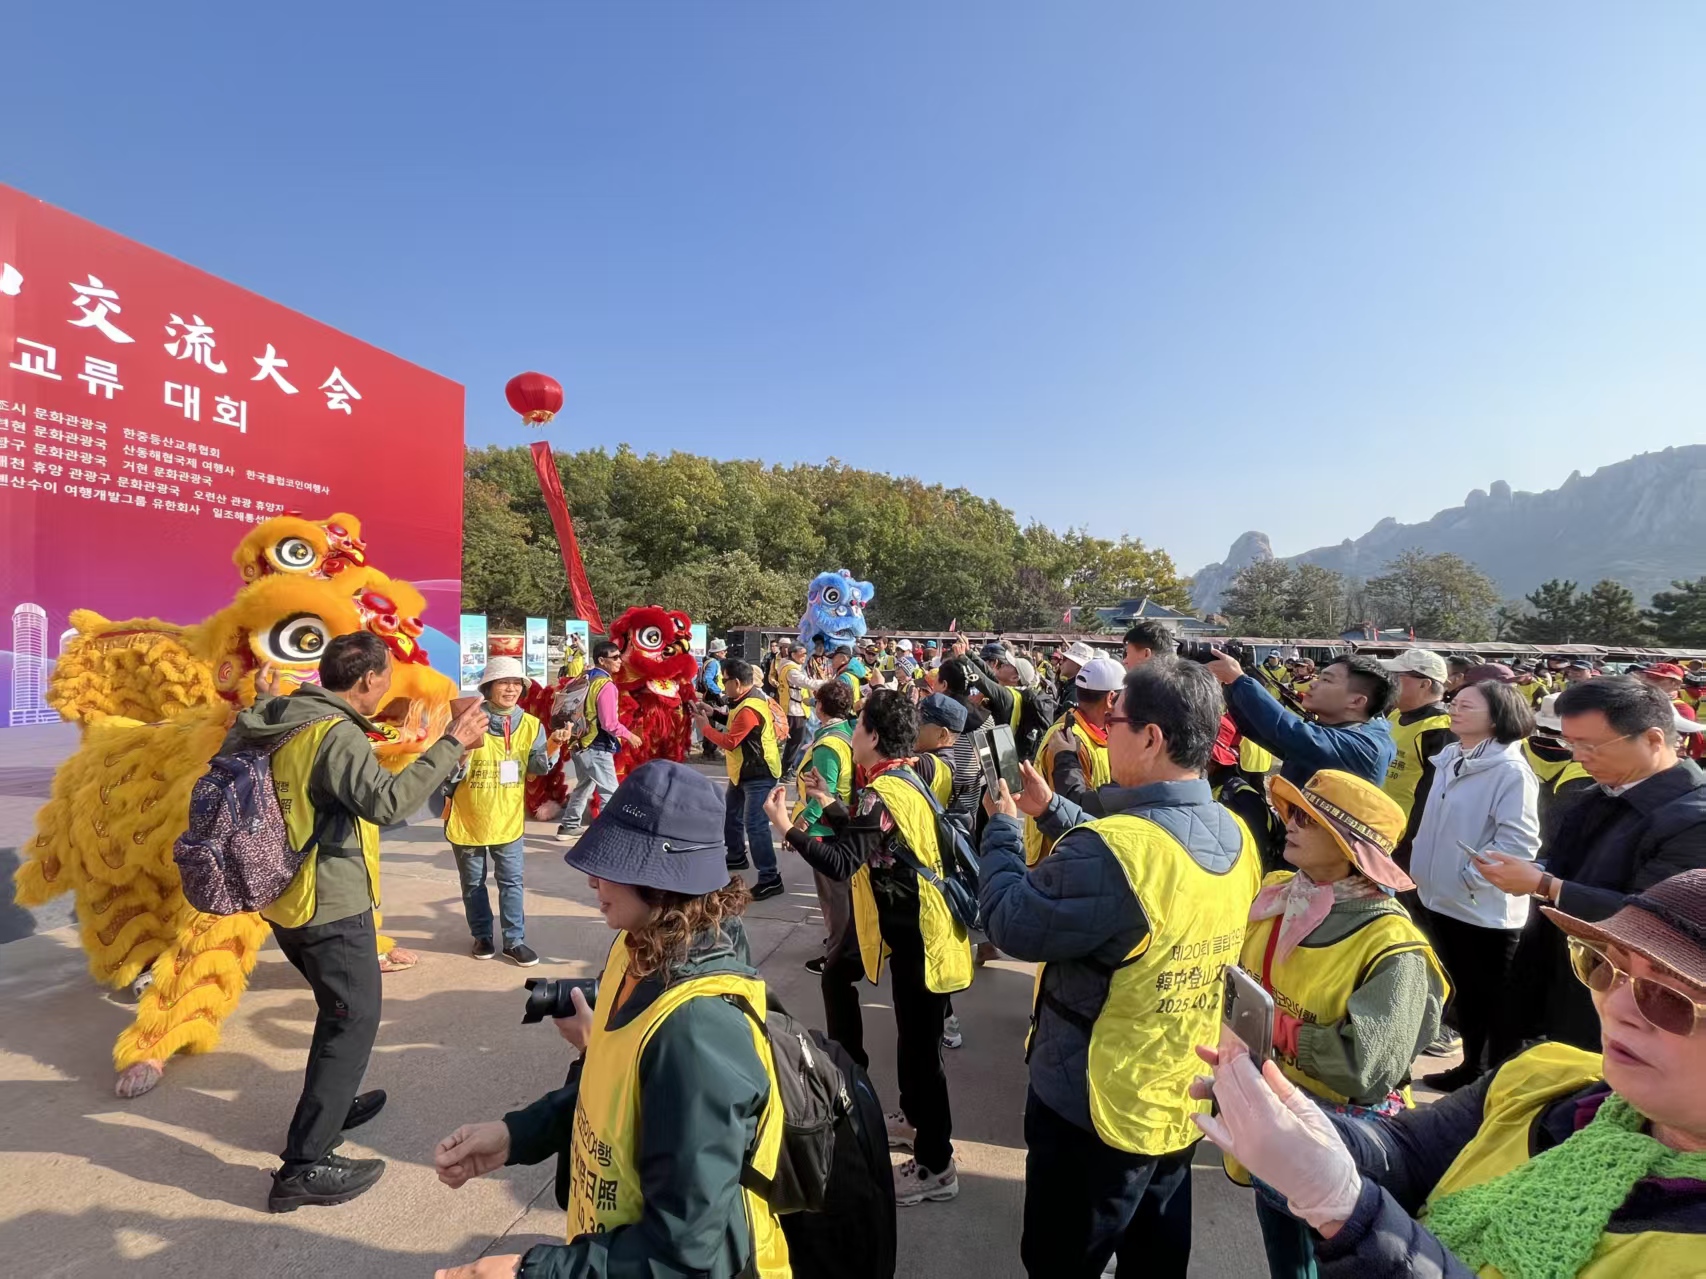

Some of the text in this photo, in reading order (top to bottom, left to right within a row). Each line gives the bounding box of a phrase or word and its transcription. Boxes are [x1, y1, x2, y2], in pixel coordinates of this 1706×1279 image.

[9, 337, 247, 434] 교류 대회
[33, 407, 108, 434] 문화관광국
[122, 427, 220, 459] 한중등산교류협회
[33, 425, 108, 451] 문화관광국
[122, 444, 198, 469] 산동해협국제
[201, 460, 236, 477] 여행사
[246, 469, 330, 495] 한국클럽코인여행사
[33, 443, 108, 468] 문화관광국
[122, 460, 148, 475] 거현
[153, 466, 213, 487] 문화관광국
[32, 461, 63, 477] 휴양
[68, 467, 112, 485] 관광구
[117, 476, 181, 497] 문화관광국
[193, 490, 227, 505] 오련산
[230, 496, 252, 509] 관광
[64, 484, 147, 508] 여행개발그룹
[152, 498, 200, 515] 유한회사
[622, 804, 646, 818] eider
[1169, 939, 1210, 962] 제20회
